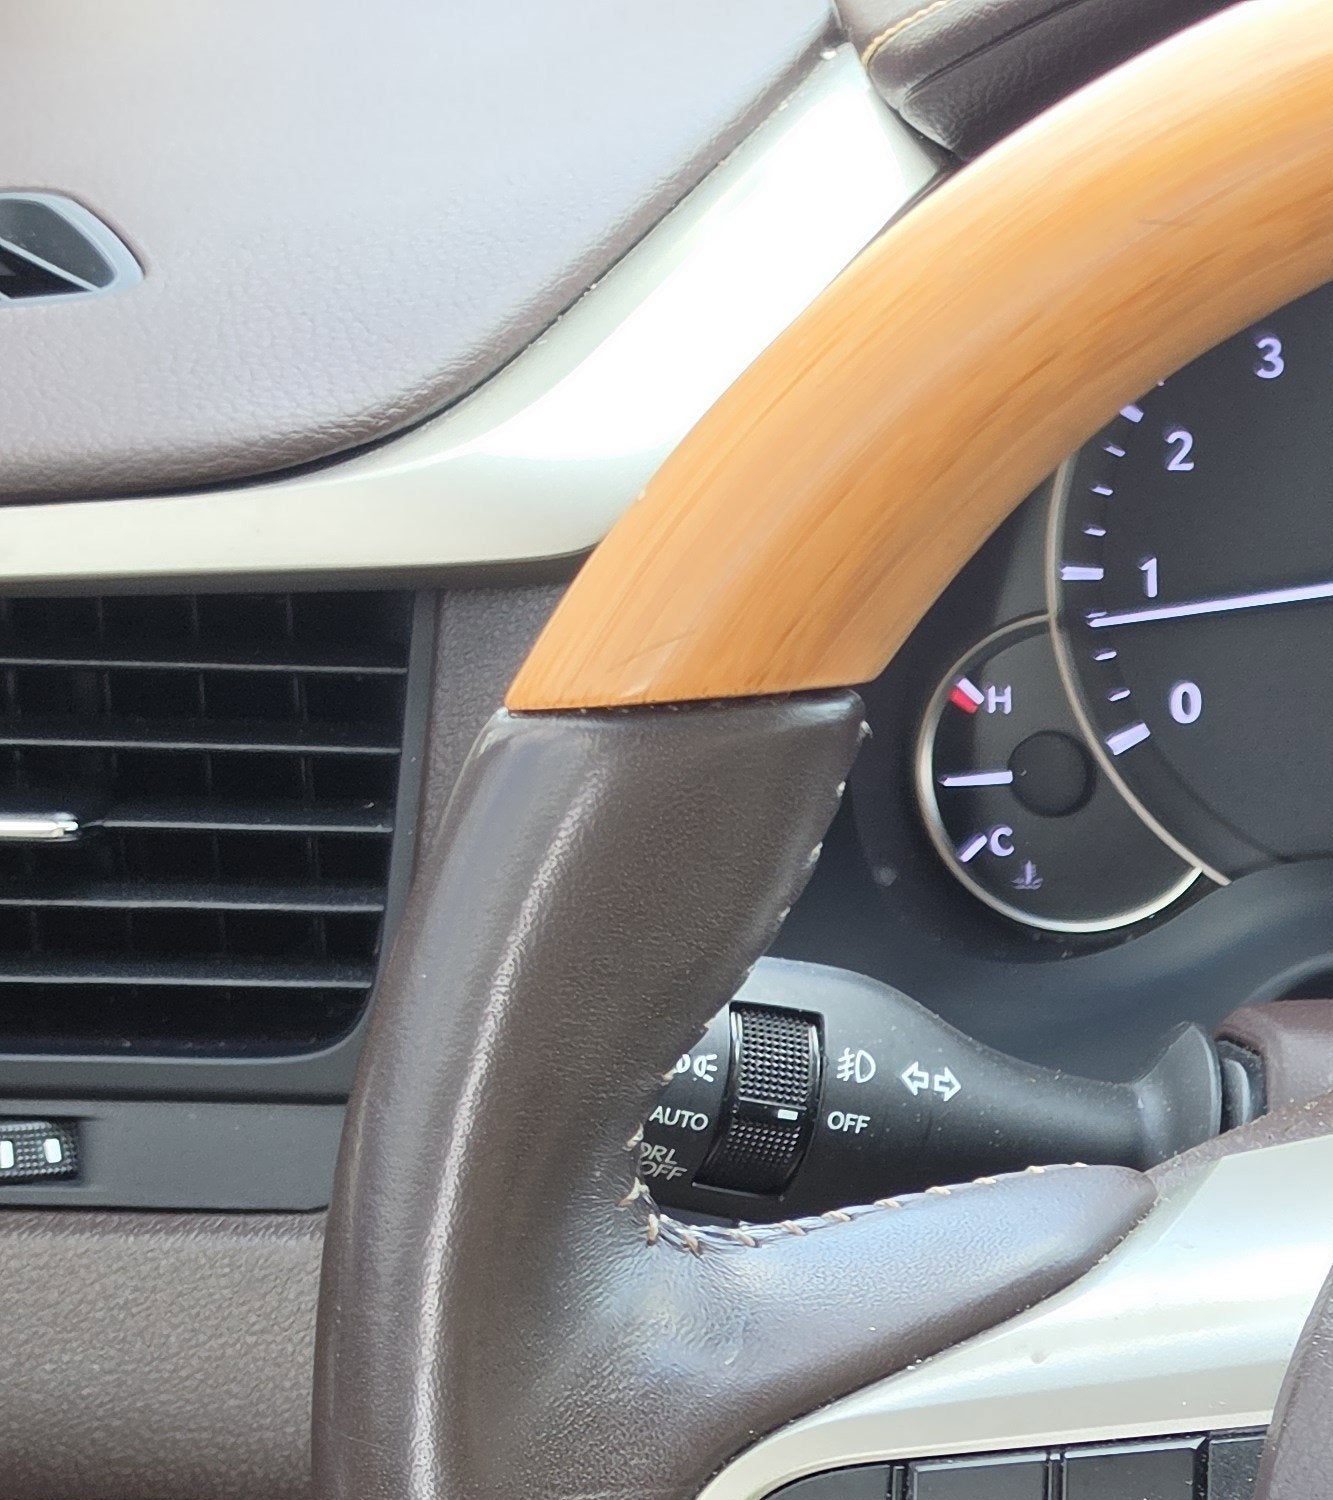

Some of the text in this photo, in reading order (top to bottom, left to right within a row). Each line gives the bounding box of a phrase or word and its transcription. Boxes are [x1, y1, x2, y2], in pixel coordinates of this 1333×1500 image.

[1255, 337, 1285, 379] 3
[1166, 431, 1195, 472] 2
[1138, 557, 1158, 598] 1
[986, 685, 1013, 714] H
[1170, 681, 1202, 725] 0
[990, 827, 1014, 857] C
[649, 1105, 709, 1131] AUTO
[827, 1110, 871, 1134] OFF
[640, 1160, 688, 1181] OFF
